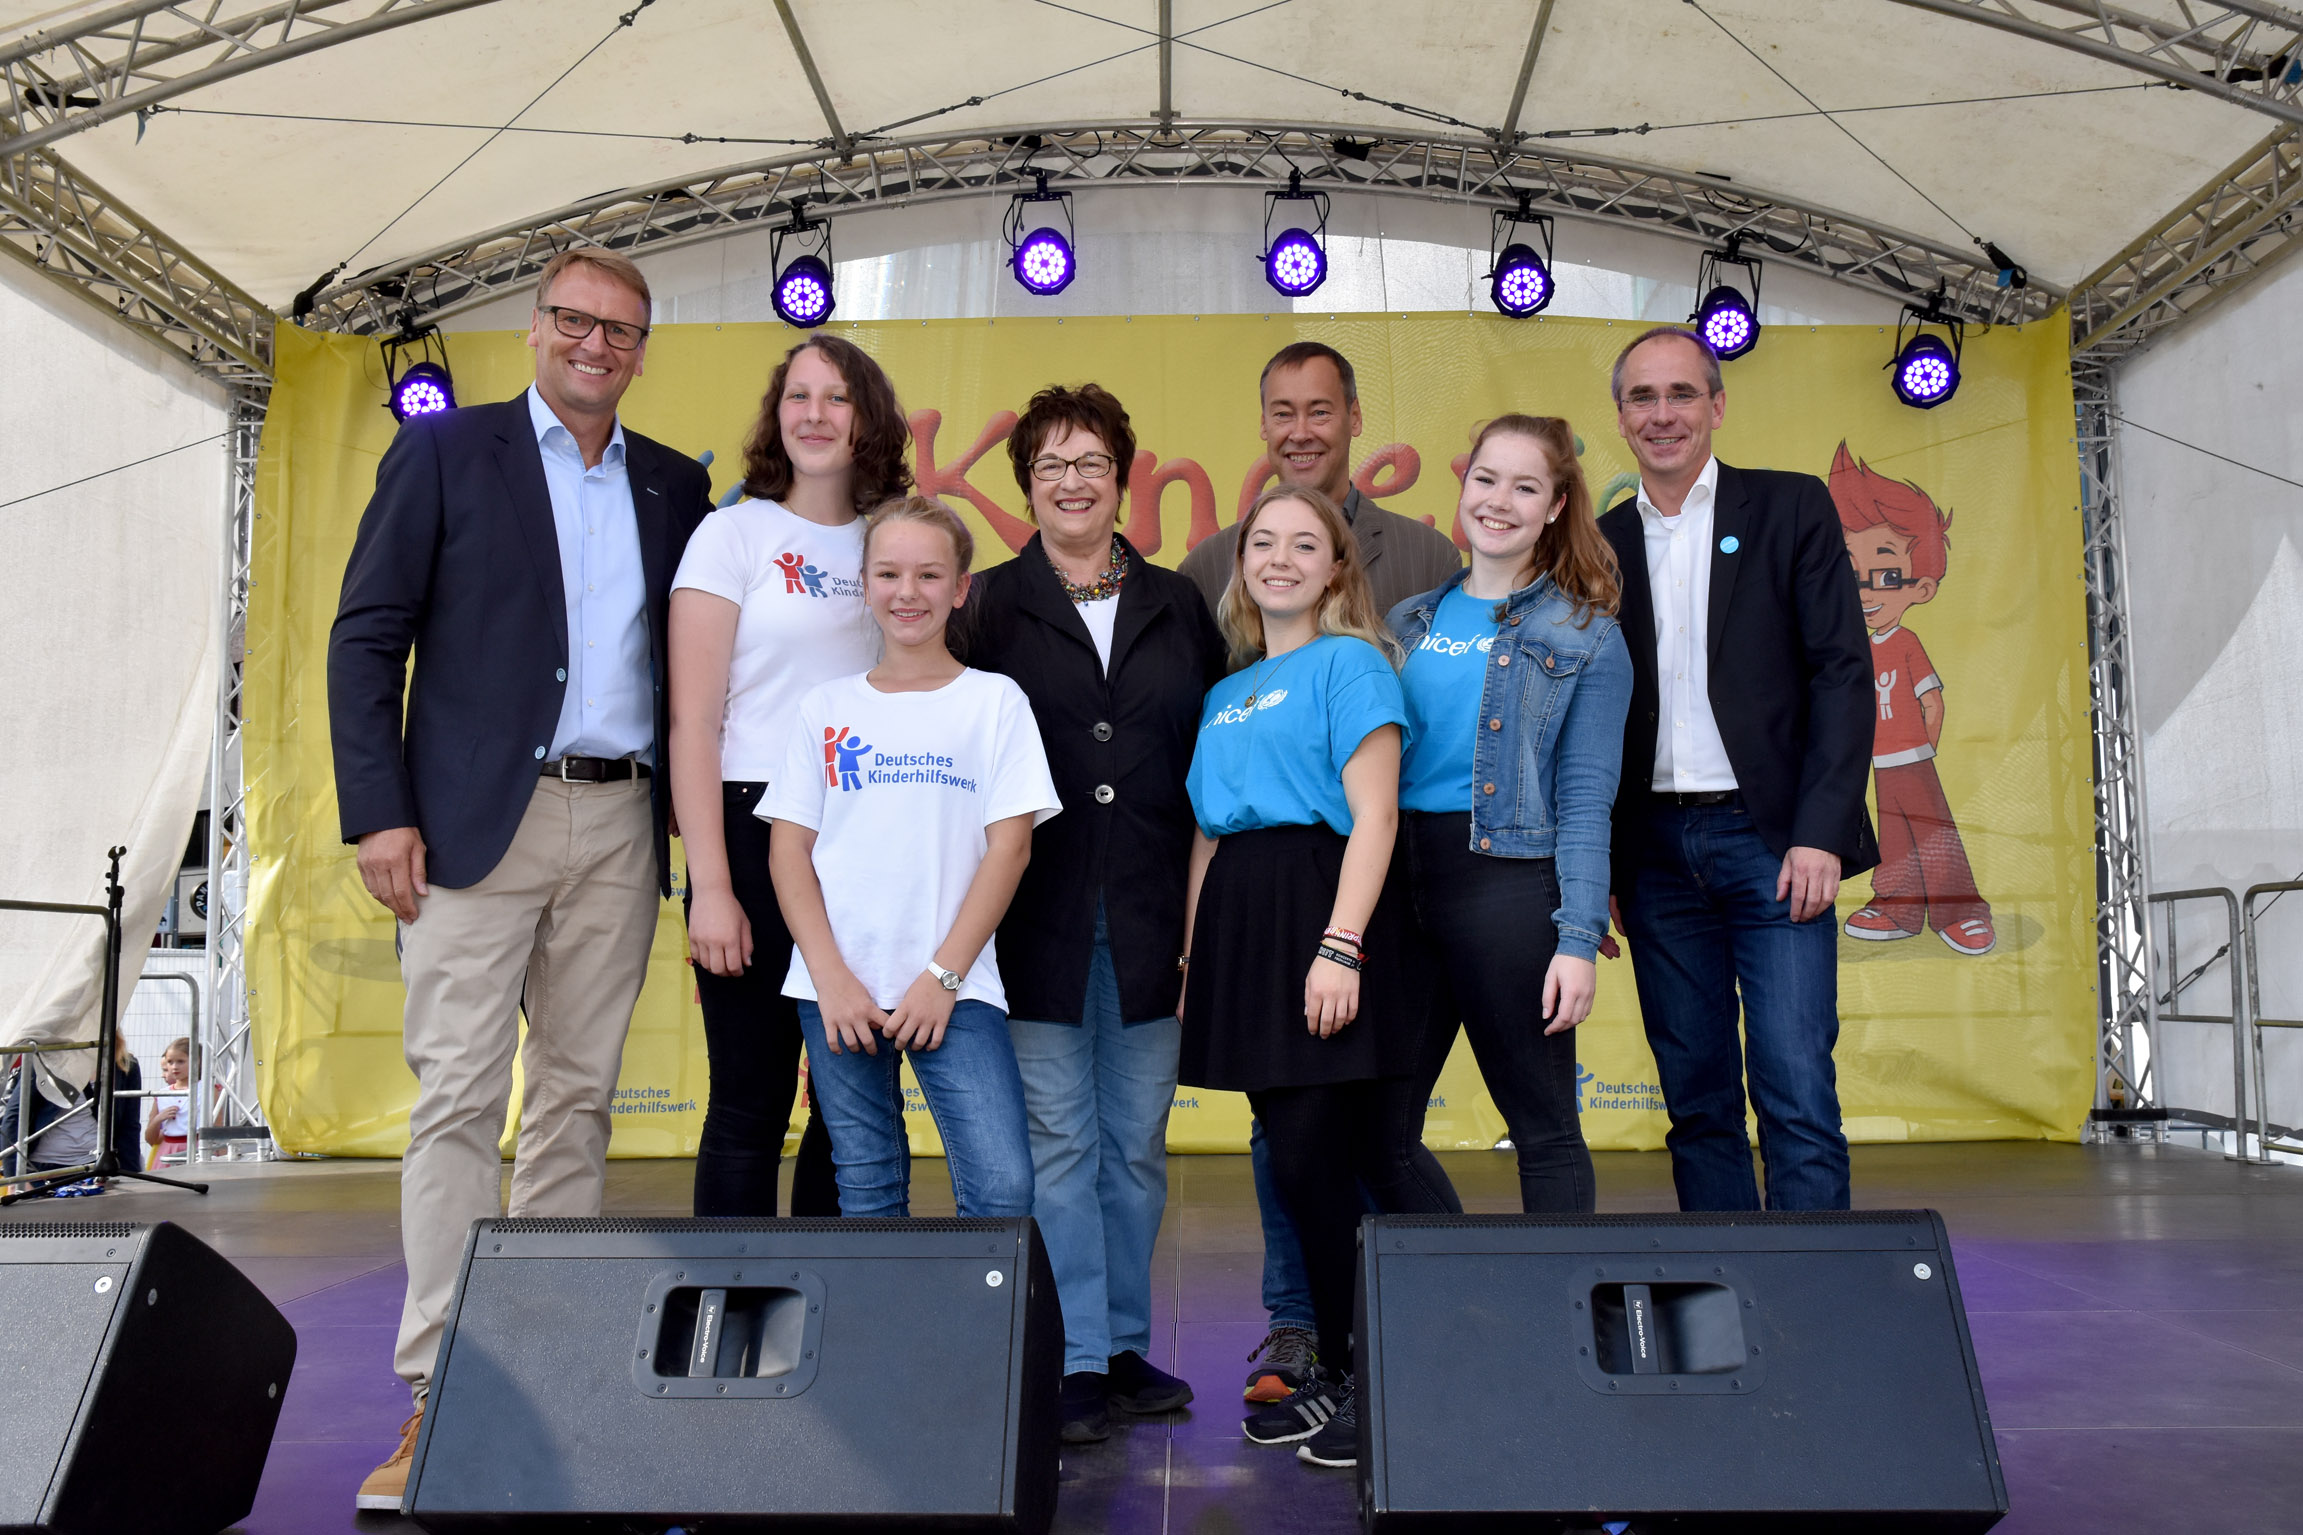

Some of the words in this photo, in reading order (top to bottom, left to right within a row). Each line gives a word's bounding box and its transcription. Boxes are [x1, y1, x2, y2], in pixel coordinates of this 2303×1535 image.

[1420, 633, 1481, 656] nicef
[875, 752, 953, 767] Deutsches
[868, 769, 977, 793] Kinderhilfswerk
[614, 1086, 671, 1099] eutsches
[1596, 1081, 1660, 1094] Deutsches
[609, 1099, 697, 1114] nderhilfswerk
[1589, 1097, 1668, 1111] Kinderhilfsw
[699, 1314, 714, 1364] Electro-Voice
[1635, 1309, 1647, 1359] Electro-Voice
